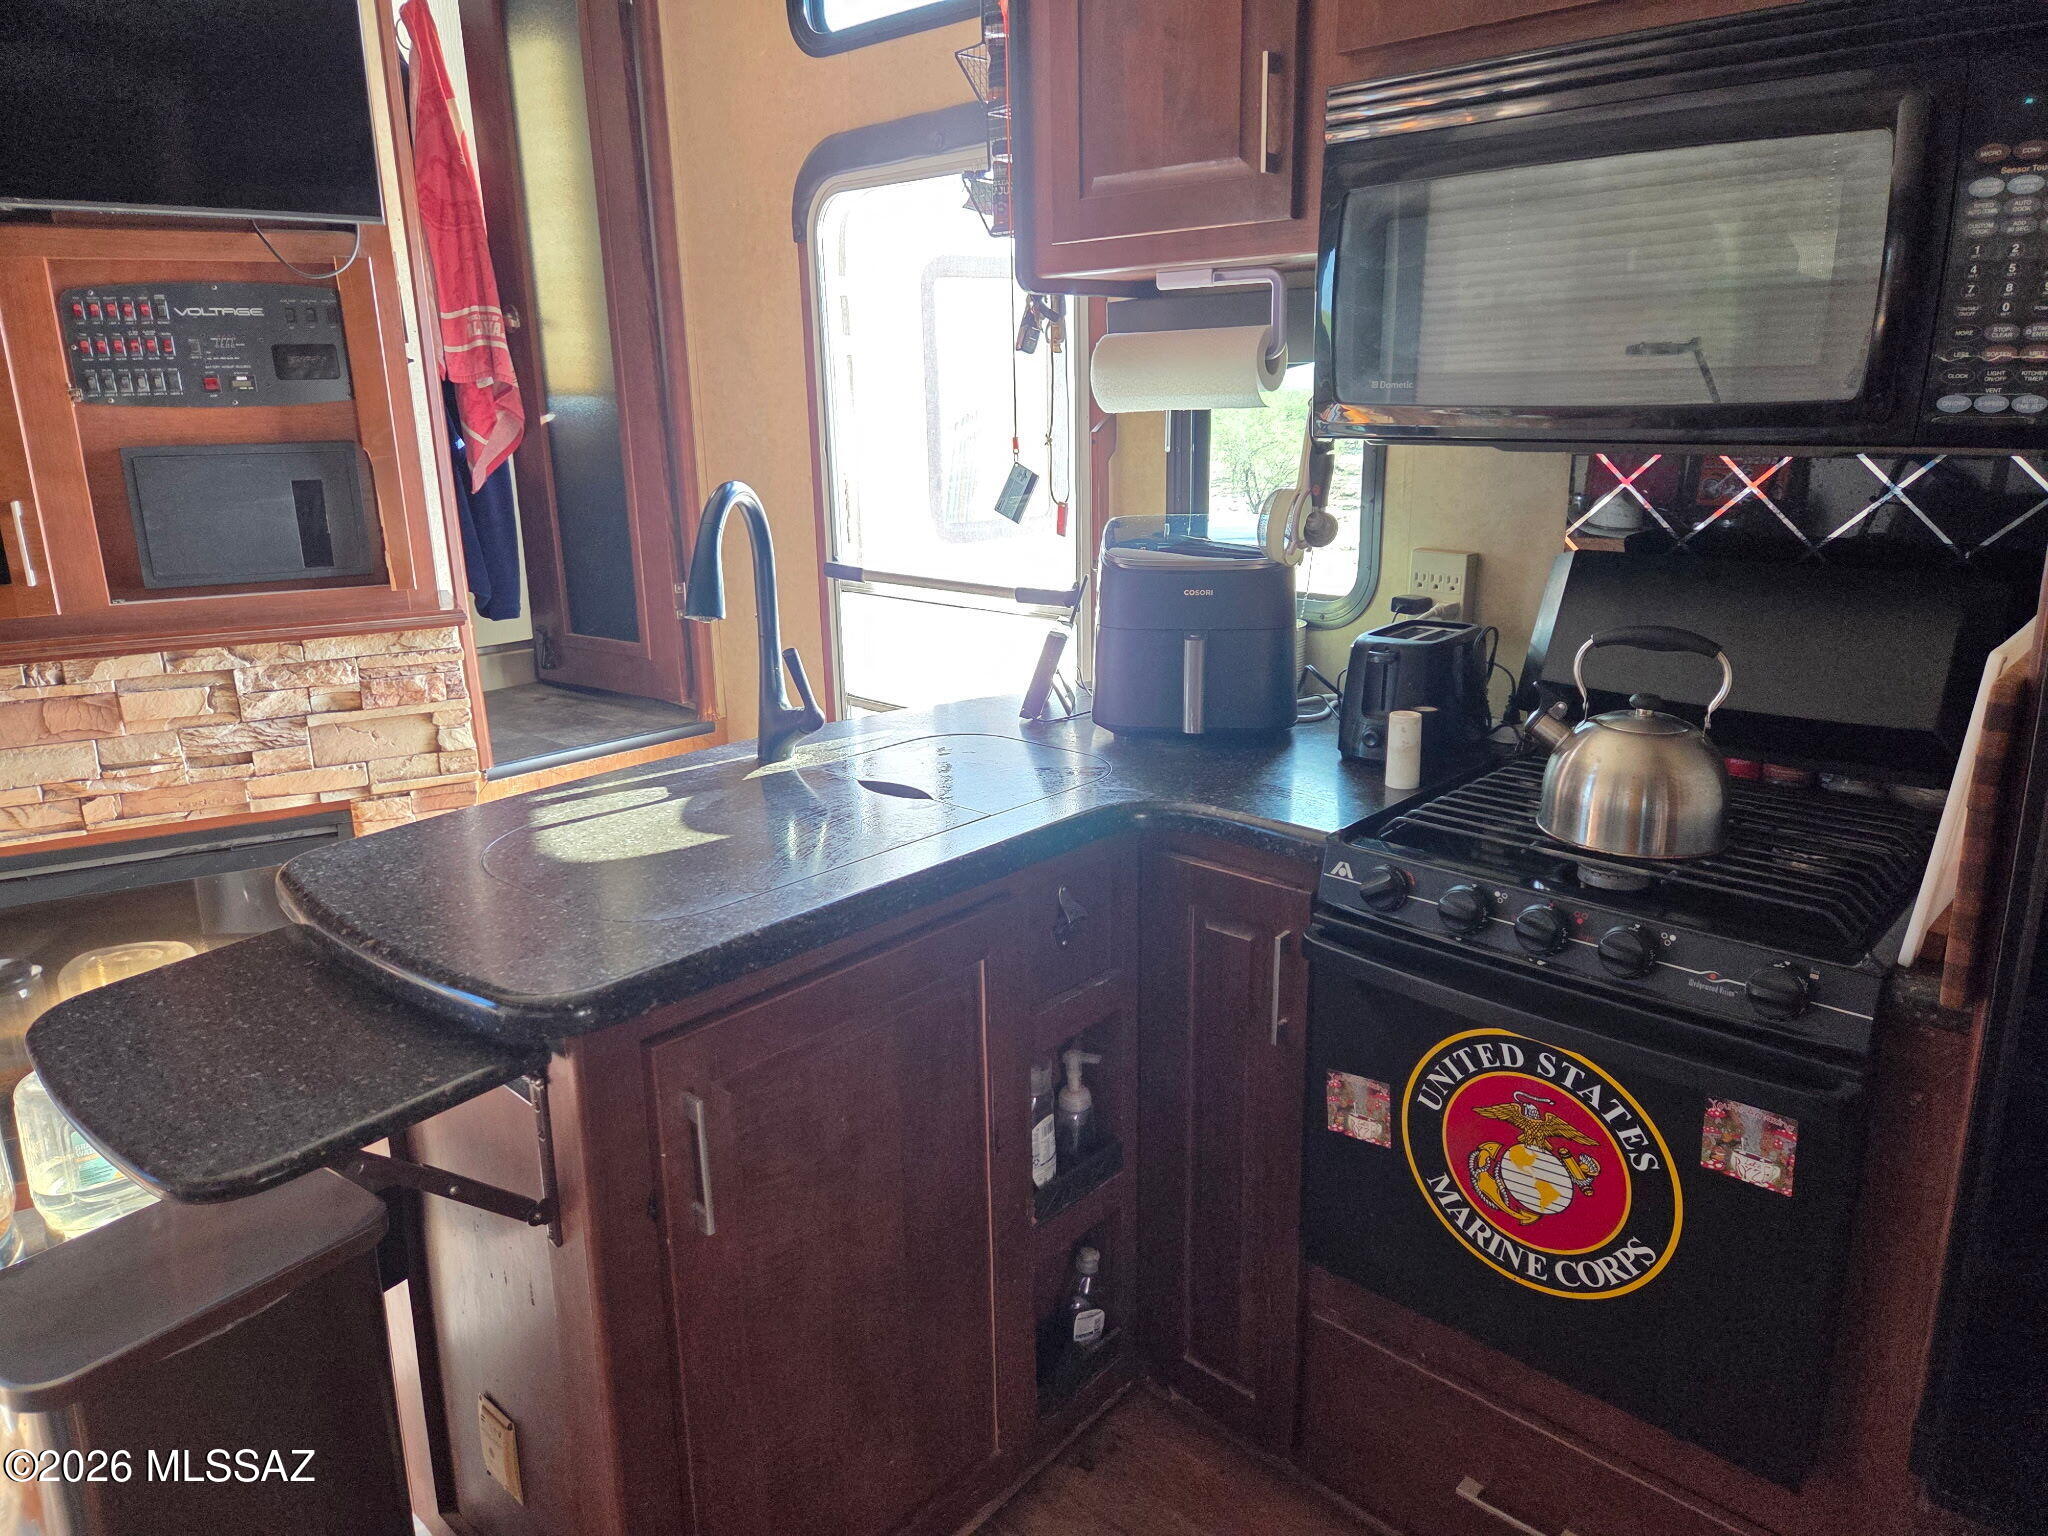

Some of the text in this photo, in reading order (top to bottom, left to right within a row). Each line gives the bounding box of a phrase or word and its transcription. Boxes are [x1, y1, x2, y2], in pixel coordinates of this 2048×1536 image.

[2001, 166, 2031, 175] Sensor
[1974, 245, 1981, 254] 1
[2011, 243, 2020, 252] 2
[1970, 264, 1977, 273] 4
[2008, 263, 2017, 272] 5
[1967, 285, 1975, 293] 7
[2005, 283, 2013, 292] 8
[2002, 302, 2010, 311] 0
[174, 307, 264, 317] VOLTAGE
[1380, 381, 1414, 389] Dometic
[1417, 1042, 1660, 1172] UNITED STATES
[1426, 1171, 1657, 1289] MARINE CORPS
